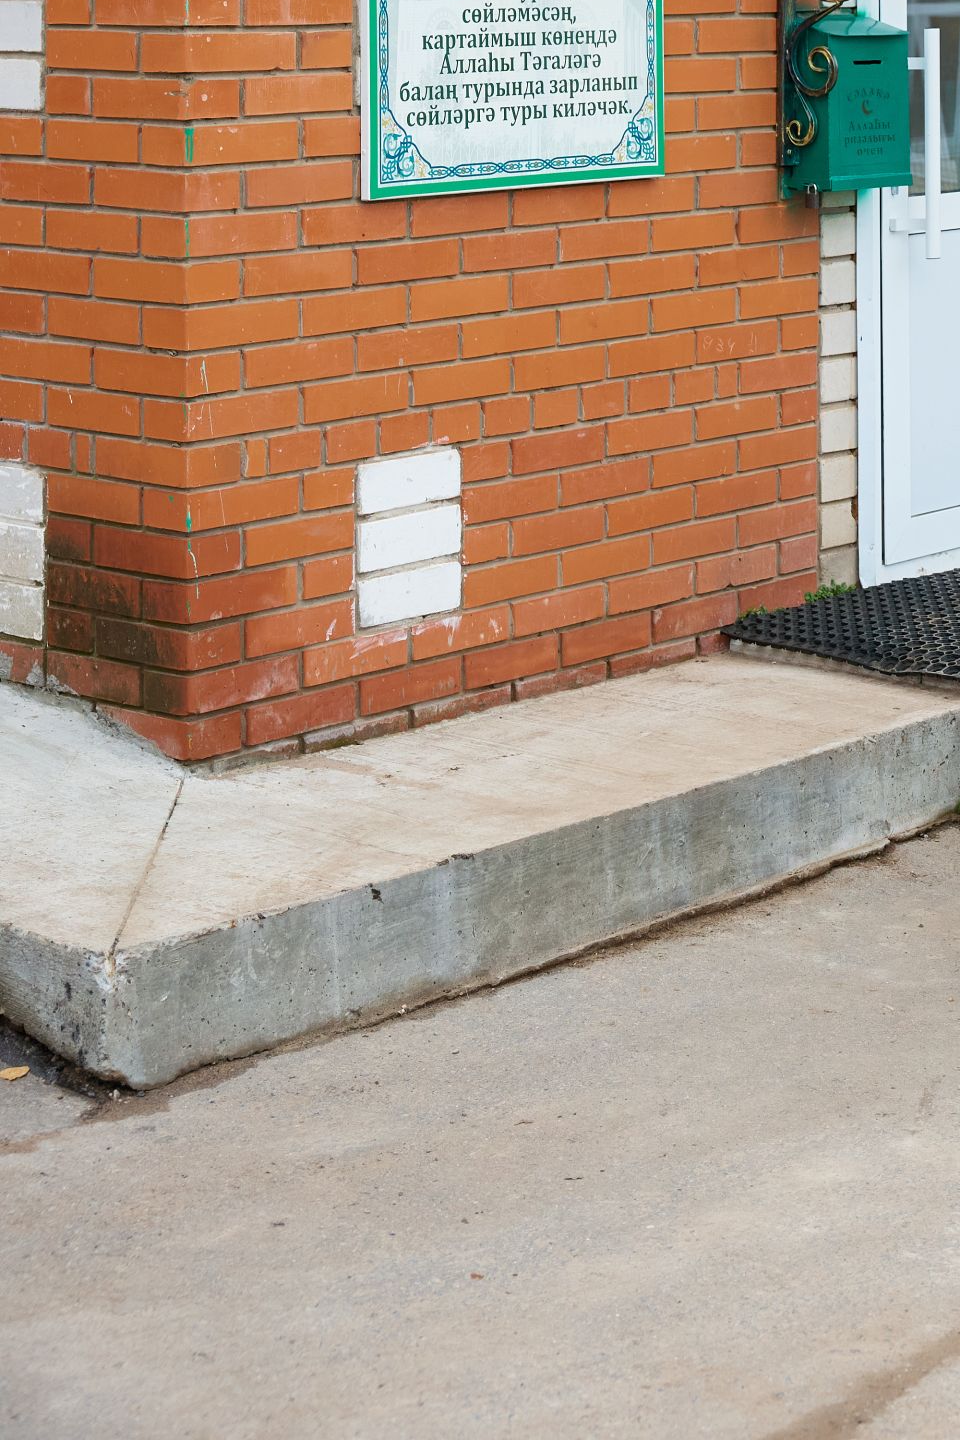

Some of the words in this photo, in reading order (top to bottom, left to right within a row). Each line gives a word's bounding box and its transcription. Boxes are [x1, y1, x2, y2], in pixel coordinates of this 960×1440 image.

[462, 3, 576, 24] сөйләмәсәң,
[422, 28, 536, 54] картаймыш
[542, 30, 616, 48] көнеңдә
[440, 50, 514, 74] Аллаһы
[520, 52, 601, 70] Тәгаләгә
[400, 81, 458, 103] балаң
[462, 81, 544, 103] турында
[550, 76, 637, 98] зарланып
[407, 105, 495, 129] сөйләргә
[500, 105, 547, 126] туры
[553, 100, 632, 120] киләчәк.
